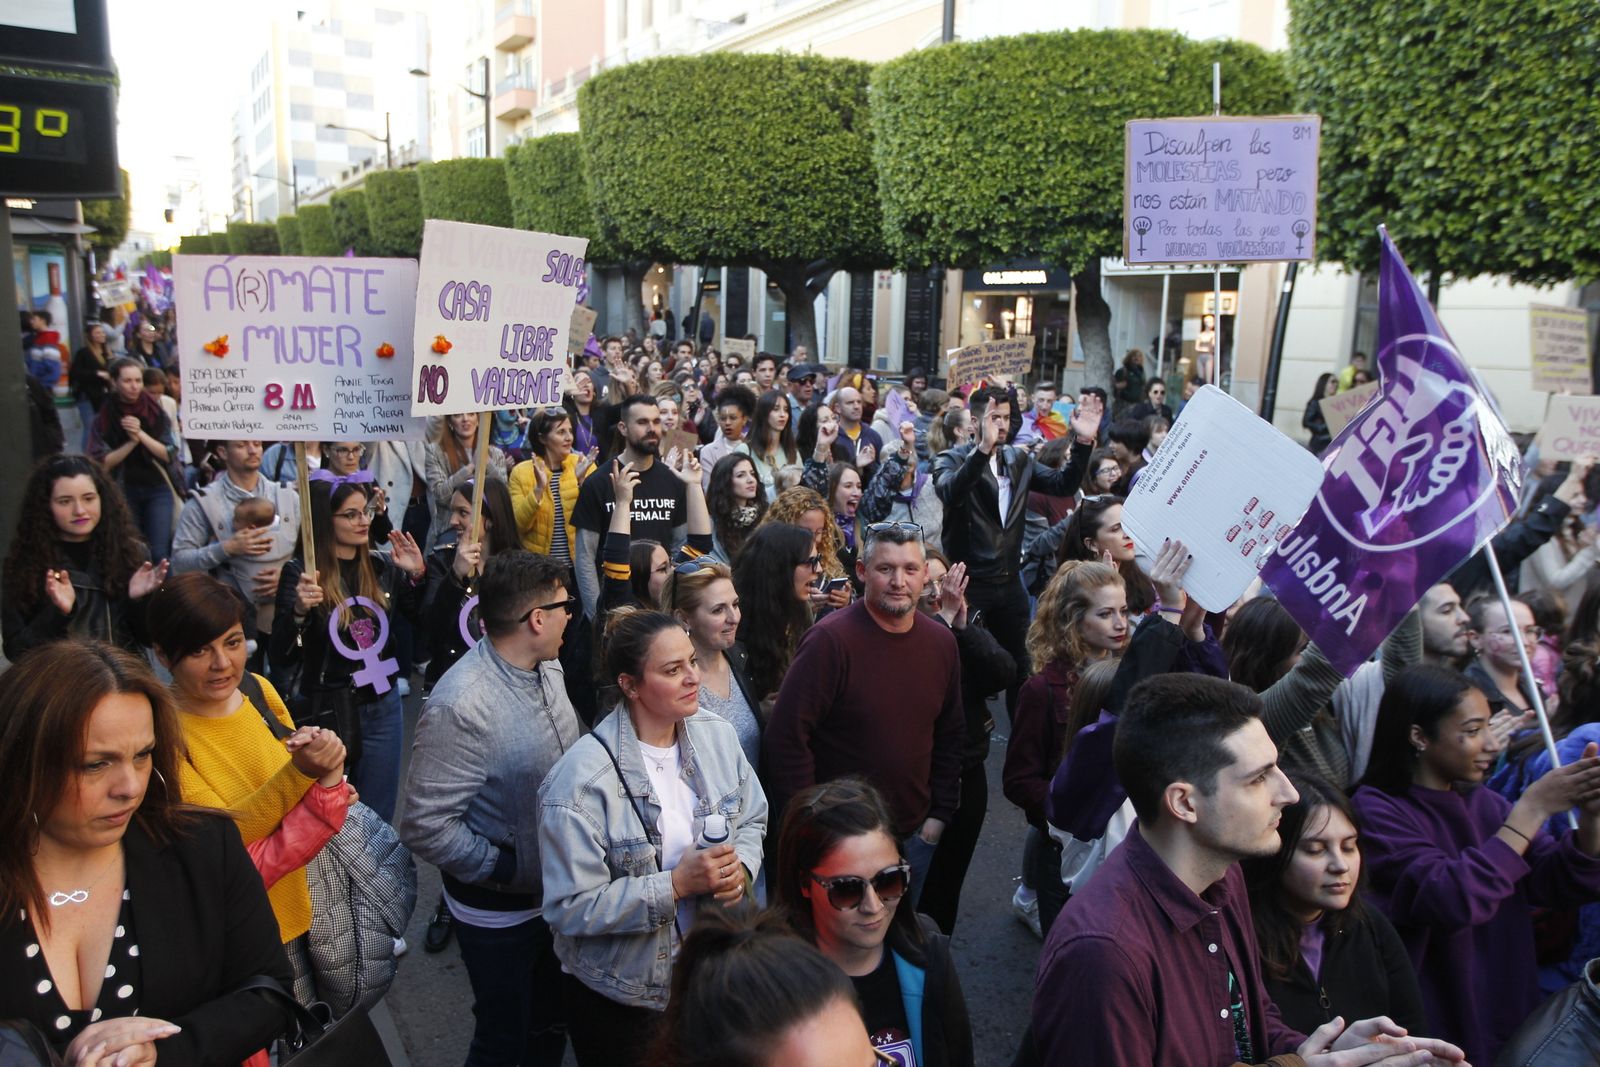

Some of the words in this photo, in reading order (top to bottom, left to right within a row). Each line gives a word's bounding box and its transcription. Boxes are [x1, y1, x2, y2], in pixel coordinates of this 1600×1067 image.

[1144, 129, 1231, 163] Disculpen
[1249, 128, 1271, 155] las
[1292, 126, 1312, 140] 8M
[1136, 160, 1242, 183] MOLESTIAS
[1256, 167, 1295, 189] pero
[1133, 193, 1162, 209] nos
[1214, 188, 1307, 215] MATANDO
[1157, 219, 1177, 236] Por
[1186, 218, 1222, 236] todas
[1234, 218, 1253, 237] las
[1260, 225, 1280, 240] que
[1165, 242, 1207, 257] NUNCA
[542, 250, 585, 288] SOLA
[438, 280, 492, 322] CASA
[243, 325, 363, 368] MUJER
[500, 324, 558, 363] LIBRE
[215, 368, 247, 379] BONET
[417, 364, 449, 405] NO
[470, 366, 563, 406] VALIENTE
[372, 405, 404, 419] RIERA
[333, 422, 348, 434] FU
[1149, 476, 1163, 494] 100%
[1162, 458, 1175, 476] made
[1172, 450, 1180, 458] in
[1178, 432, 1192, 451] Spain
[1167, 449, 1208, 506] www.onfoot.es
[629, 511, 671, 521] FEMALE
[633, 499, 676, 509] FUTURE
